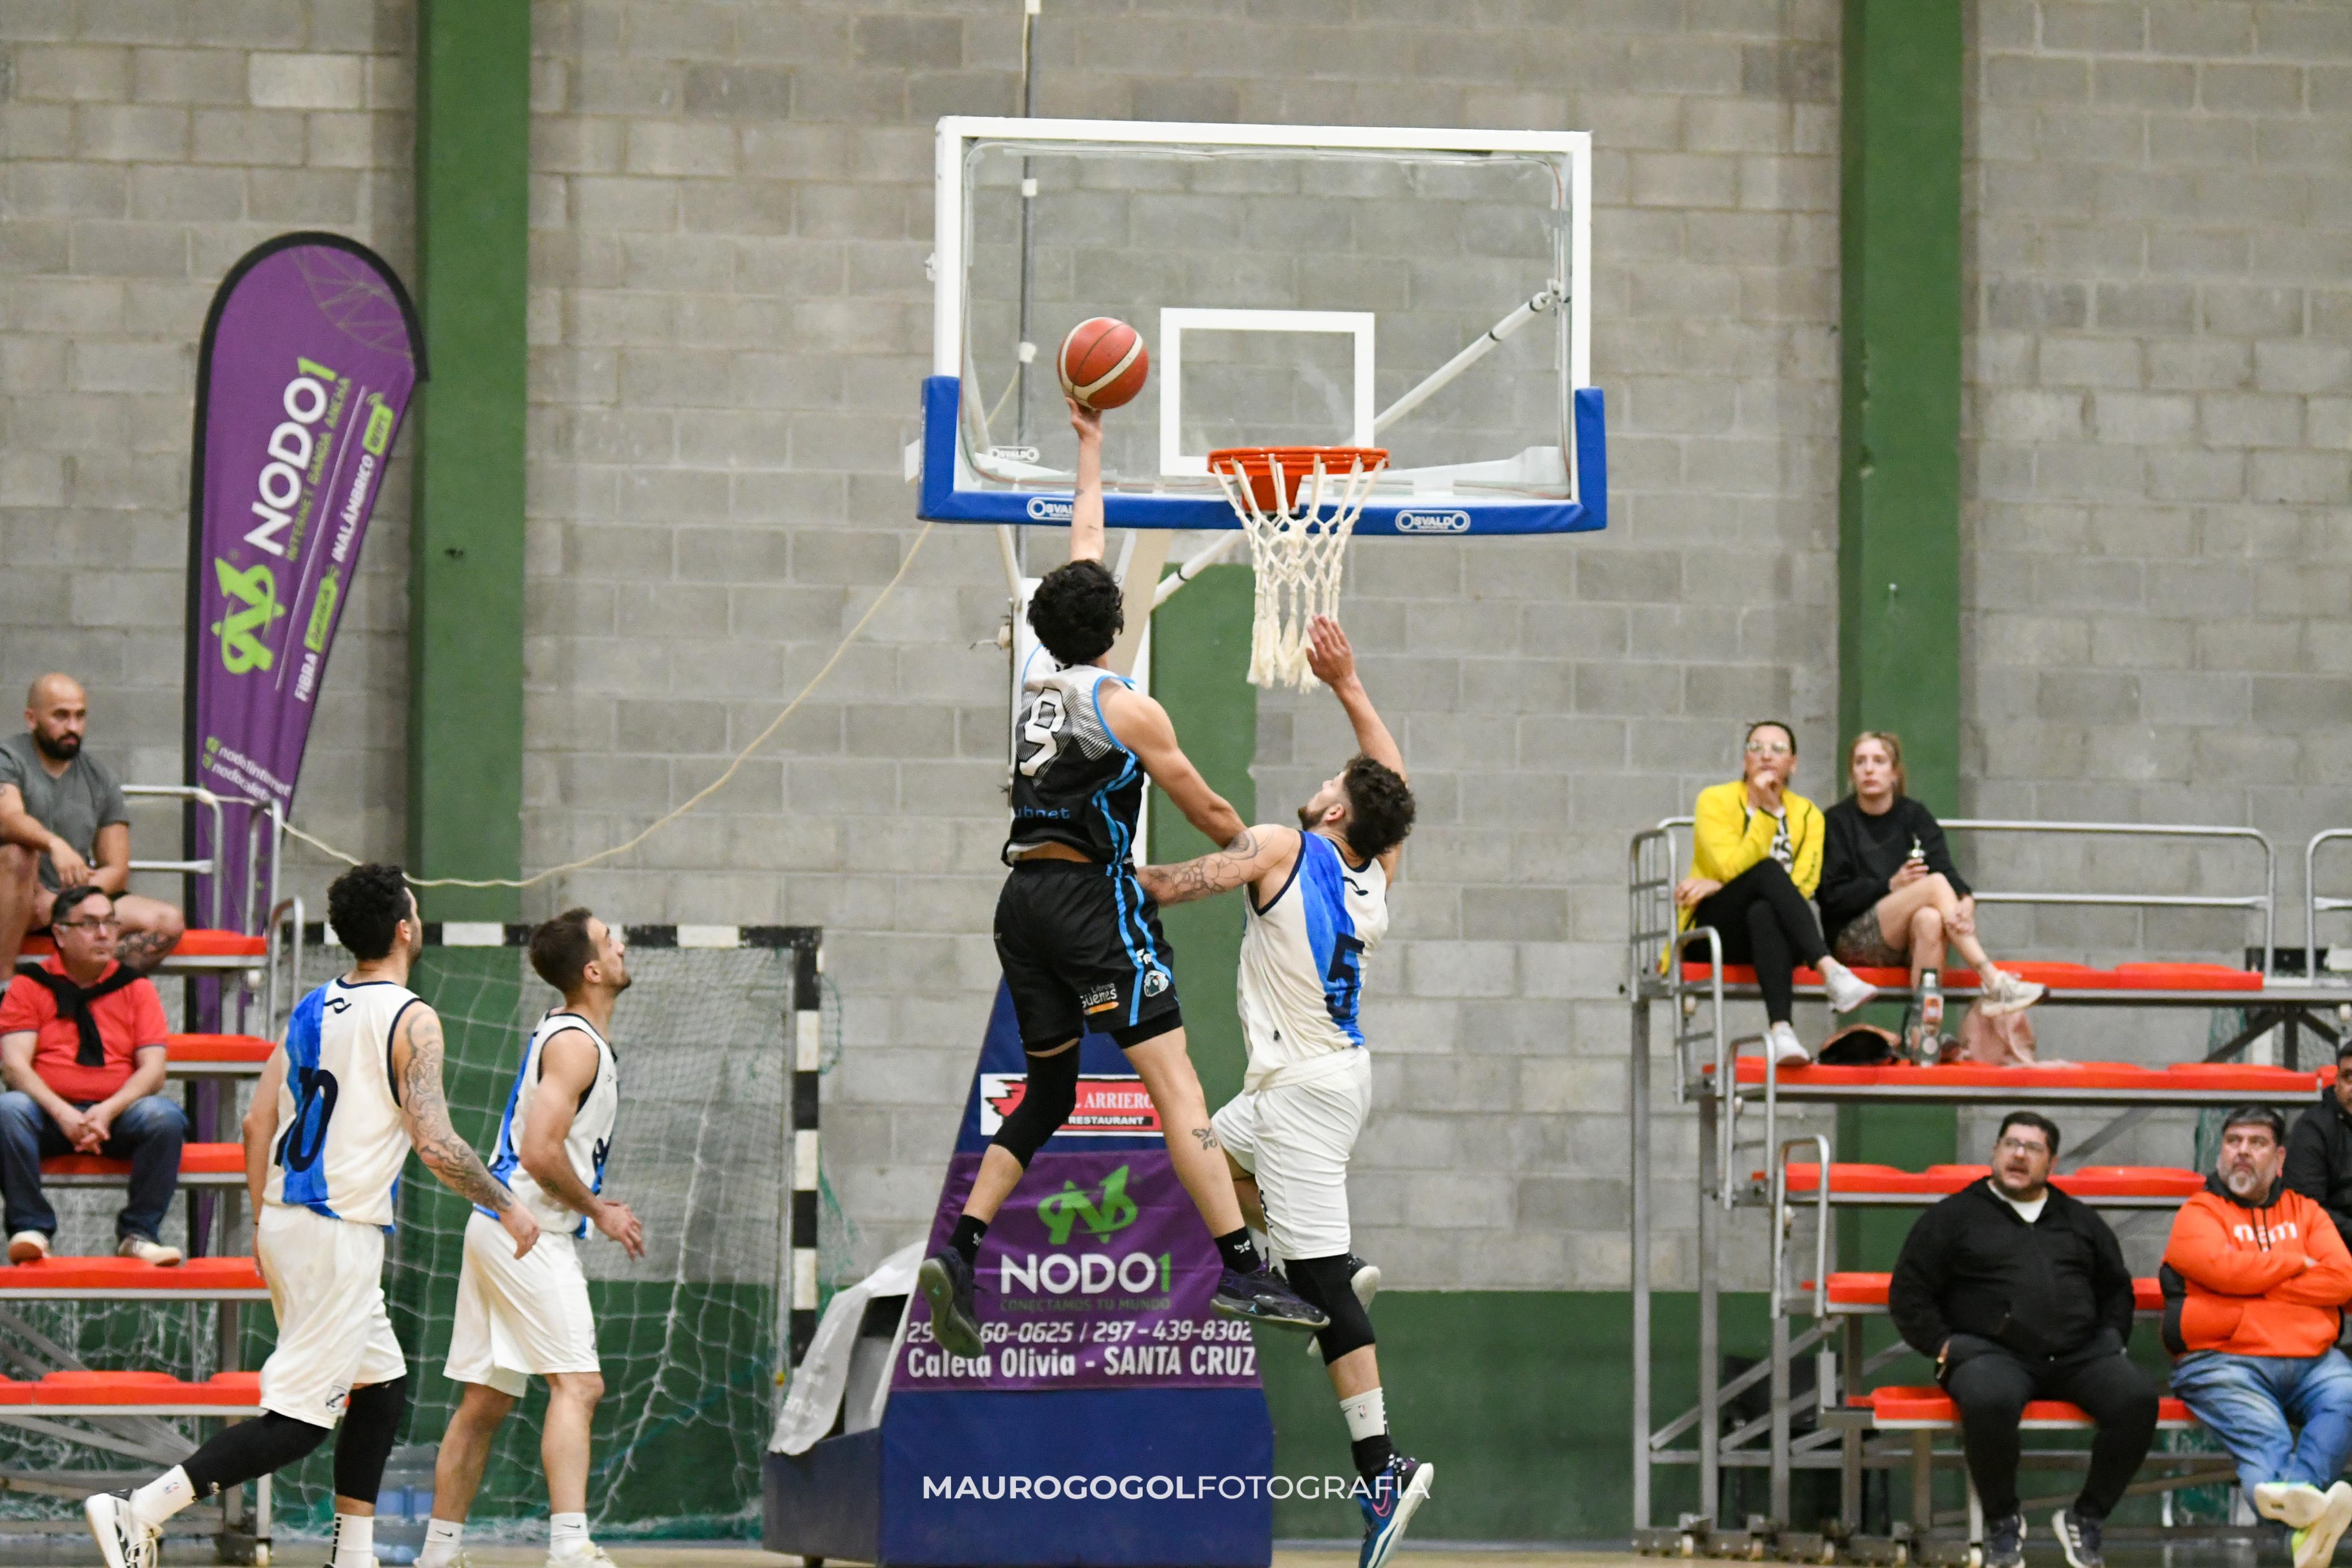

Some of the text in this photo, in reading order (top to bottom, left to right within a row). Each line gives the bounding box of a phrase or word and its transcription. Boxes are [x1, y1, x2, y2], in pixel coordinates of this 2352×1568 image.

[243, 357, 336, 557] NODO1
[1030, 499, 1074, 517] OSVAL
[1398, 513, 1465, 530] OSVALDO
[294, 652, 319, 703] FIBRA
[1018, 687, 1067, 777] 9
[1324, 932, 1365, 1018] 5
[1068, 1116, 1144, 1125] RESTAURANT
[1001, 1253, 1170, 1294] NODO1
[907, 1322, 1073, 1343] 2960-0625
[907, 1347, 991, 1378] Caleta
[1000, 1347, 1076, 1378] Olivia
[1104, 1346, 1182, 1376] SANTA
[1190, 1346, 1256, 1376] CRUZ
